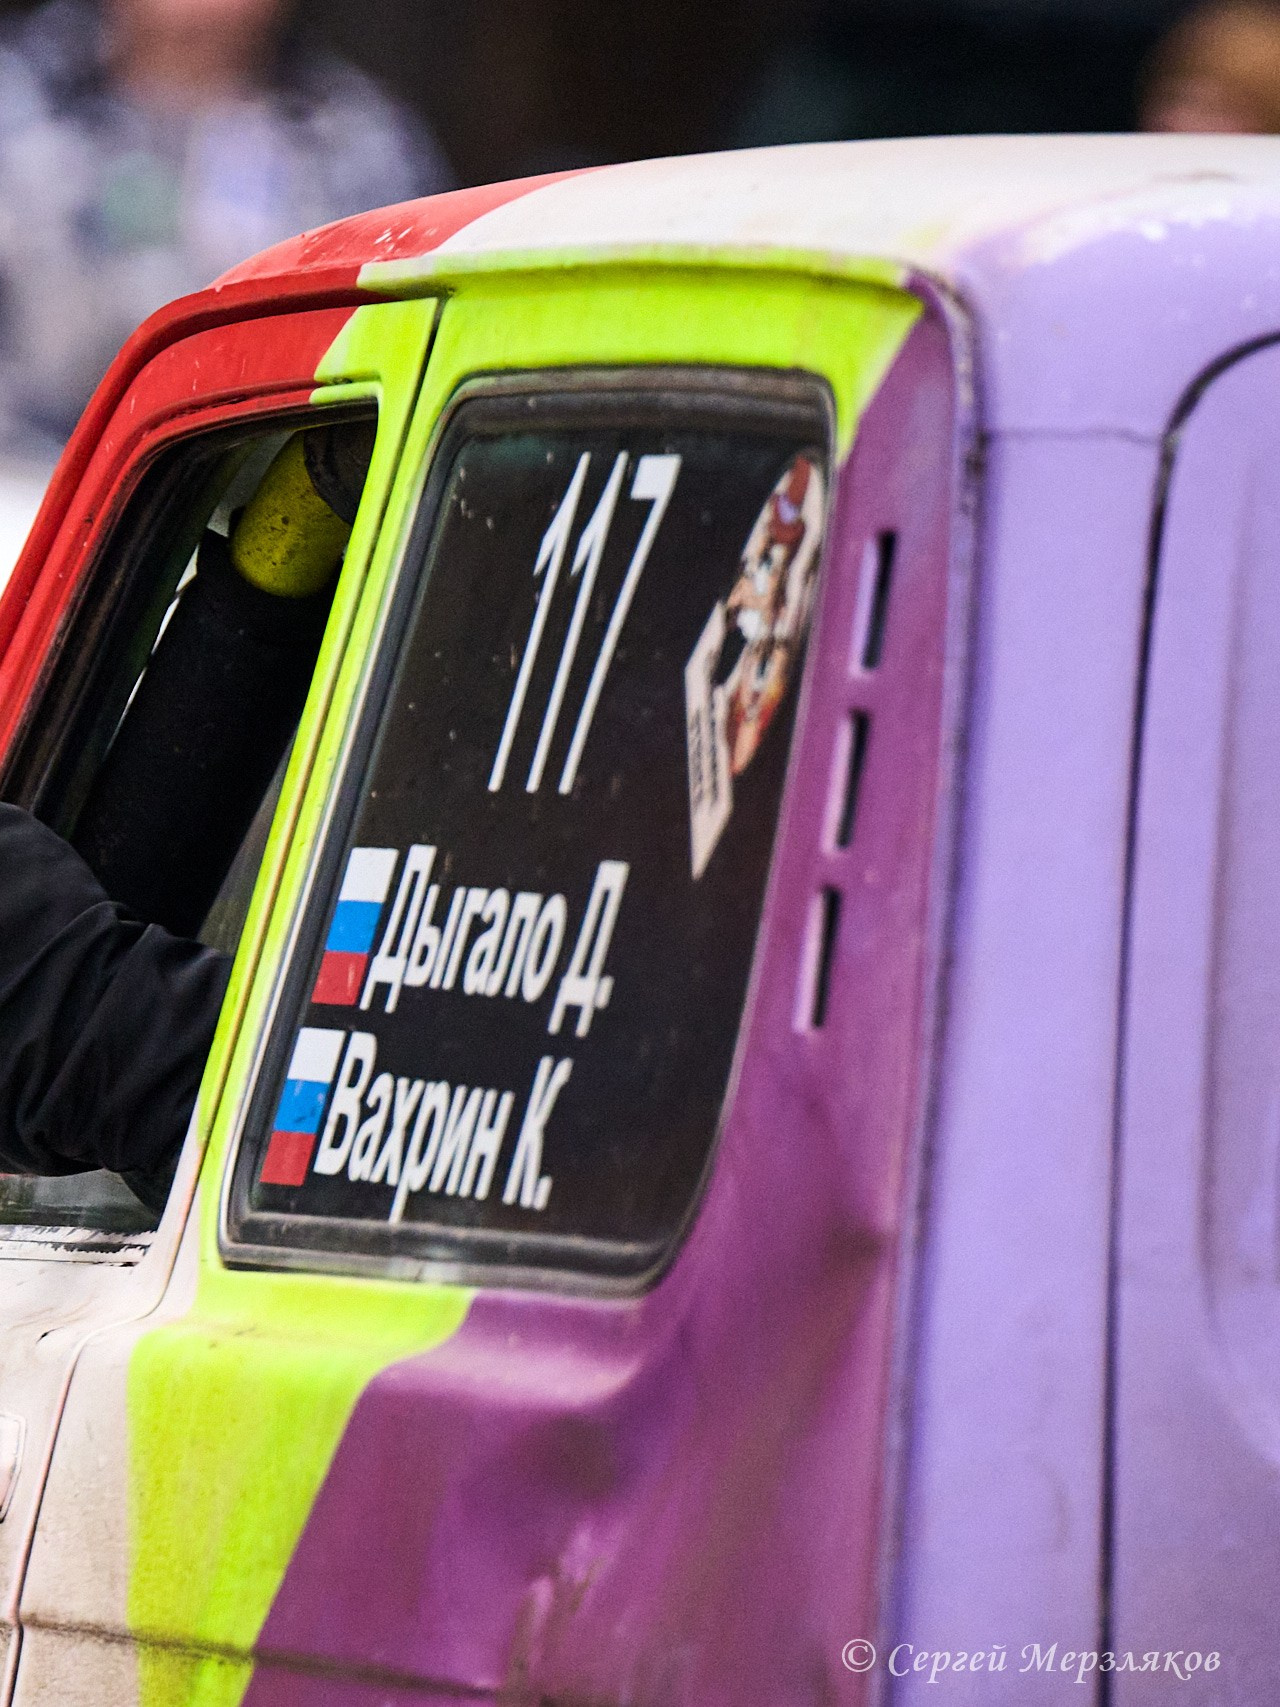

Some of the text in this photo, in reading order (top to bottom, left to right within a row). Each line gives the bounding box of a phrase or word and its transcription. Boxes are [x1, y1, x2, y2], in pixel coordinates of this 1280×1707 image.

[488, 451, 682, 793] 117
[360, 844, 629, 1037] Дыгало Д.
[313, 1031, 573, 1222] Вахрин К.
